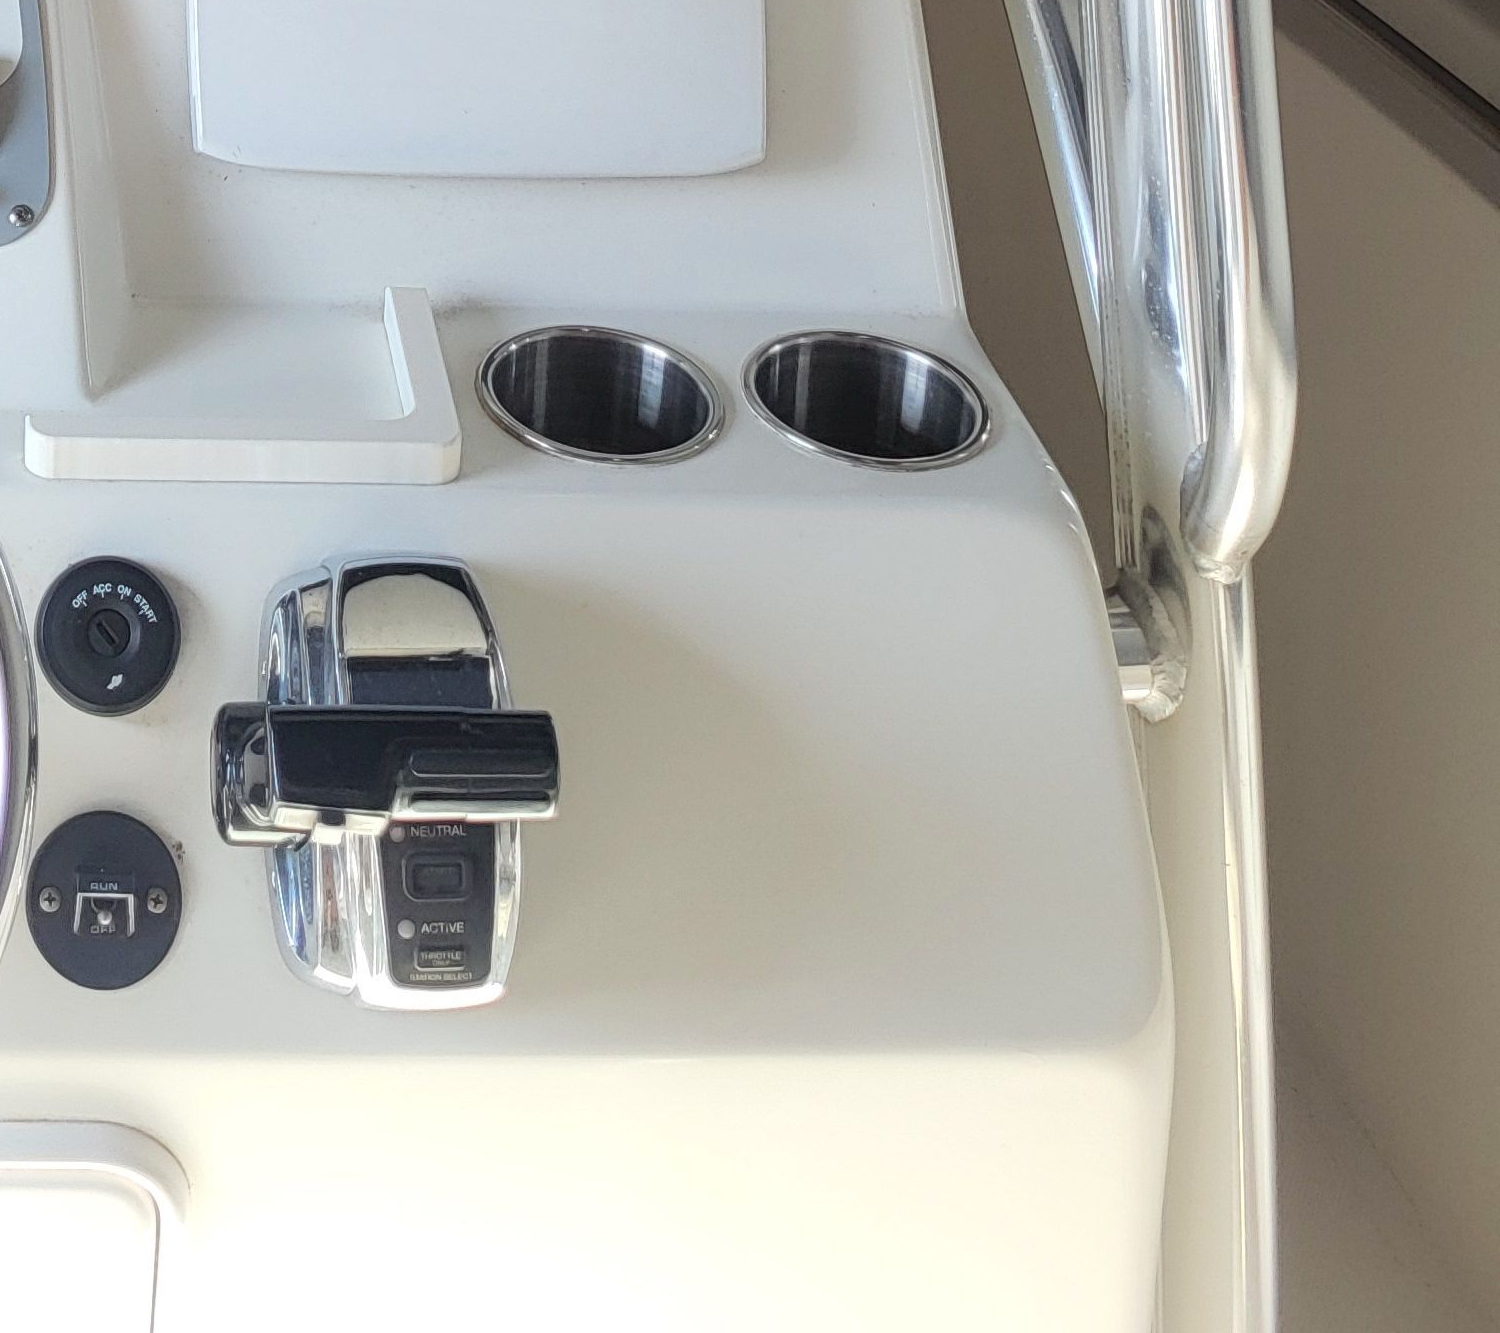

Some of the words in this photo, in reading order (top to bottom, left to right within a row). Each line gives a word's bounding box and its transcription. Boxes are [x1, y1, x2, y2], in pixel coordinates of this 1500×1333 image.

[72, 590, 88, 609] OFF
[93, 583, 112, 595] ACC
[117, 585, 132, 596] ON
[133, 594, 158, 624] START
[410, 824, 467, 838] NEUTRAL
[90, 882, 118, 891] RUN
[90, 924, 117, 934] OFF
[421, 921, 465, 934] ACTIVE
[420, 950, 463, 961] THROTTLE
